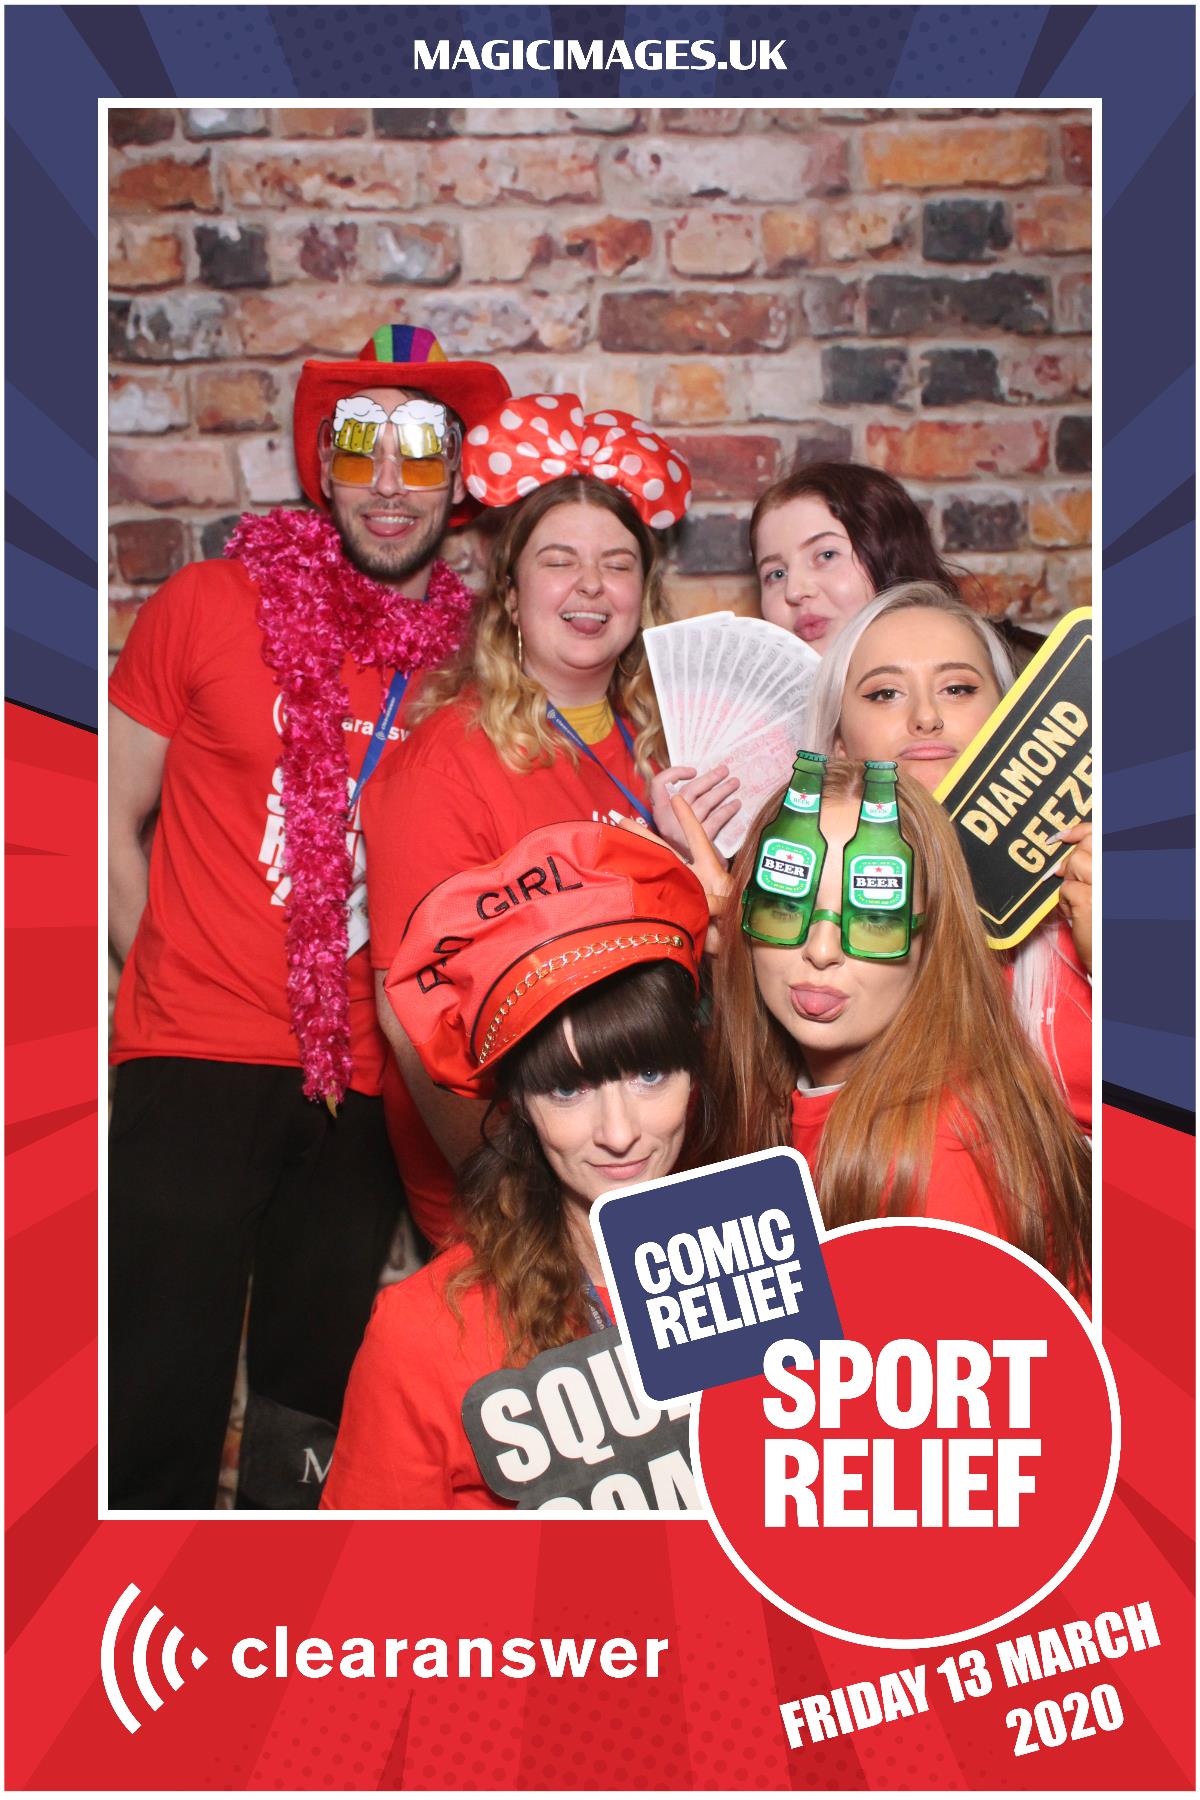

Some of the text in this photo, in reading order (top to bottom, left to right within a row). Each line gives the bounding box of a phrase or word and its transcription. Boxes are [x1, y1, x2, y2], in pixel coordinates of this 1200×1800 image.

[960, 701, 1089, 846] DIAMOND
[1007, 748, 1092, 874] GEEZE
[476, 856, 584, 920] GIRL
[763, 858, 805, 878] BEER
[855, 877, 900, 888] BEER
[480, 1343, 691, 1483] SQU
